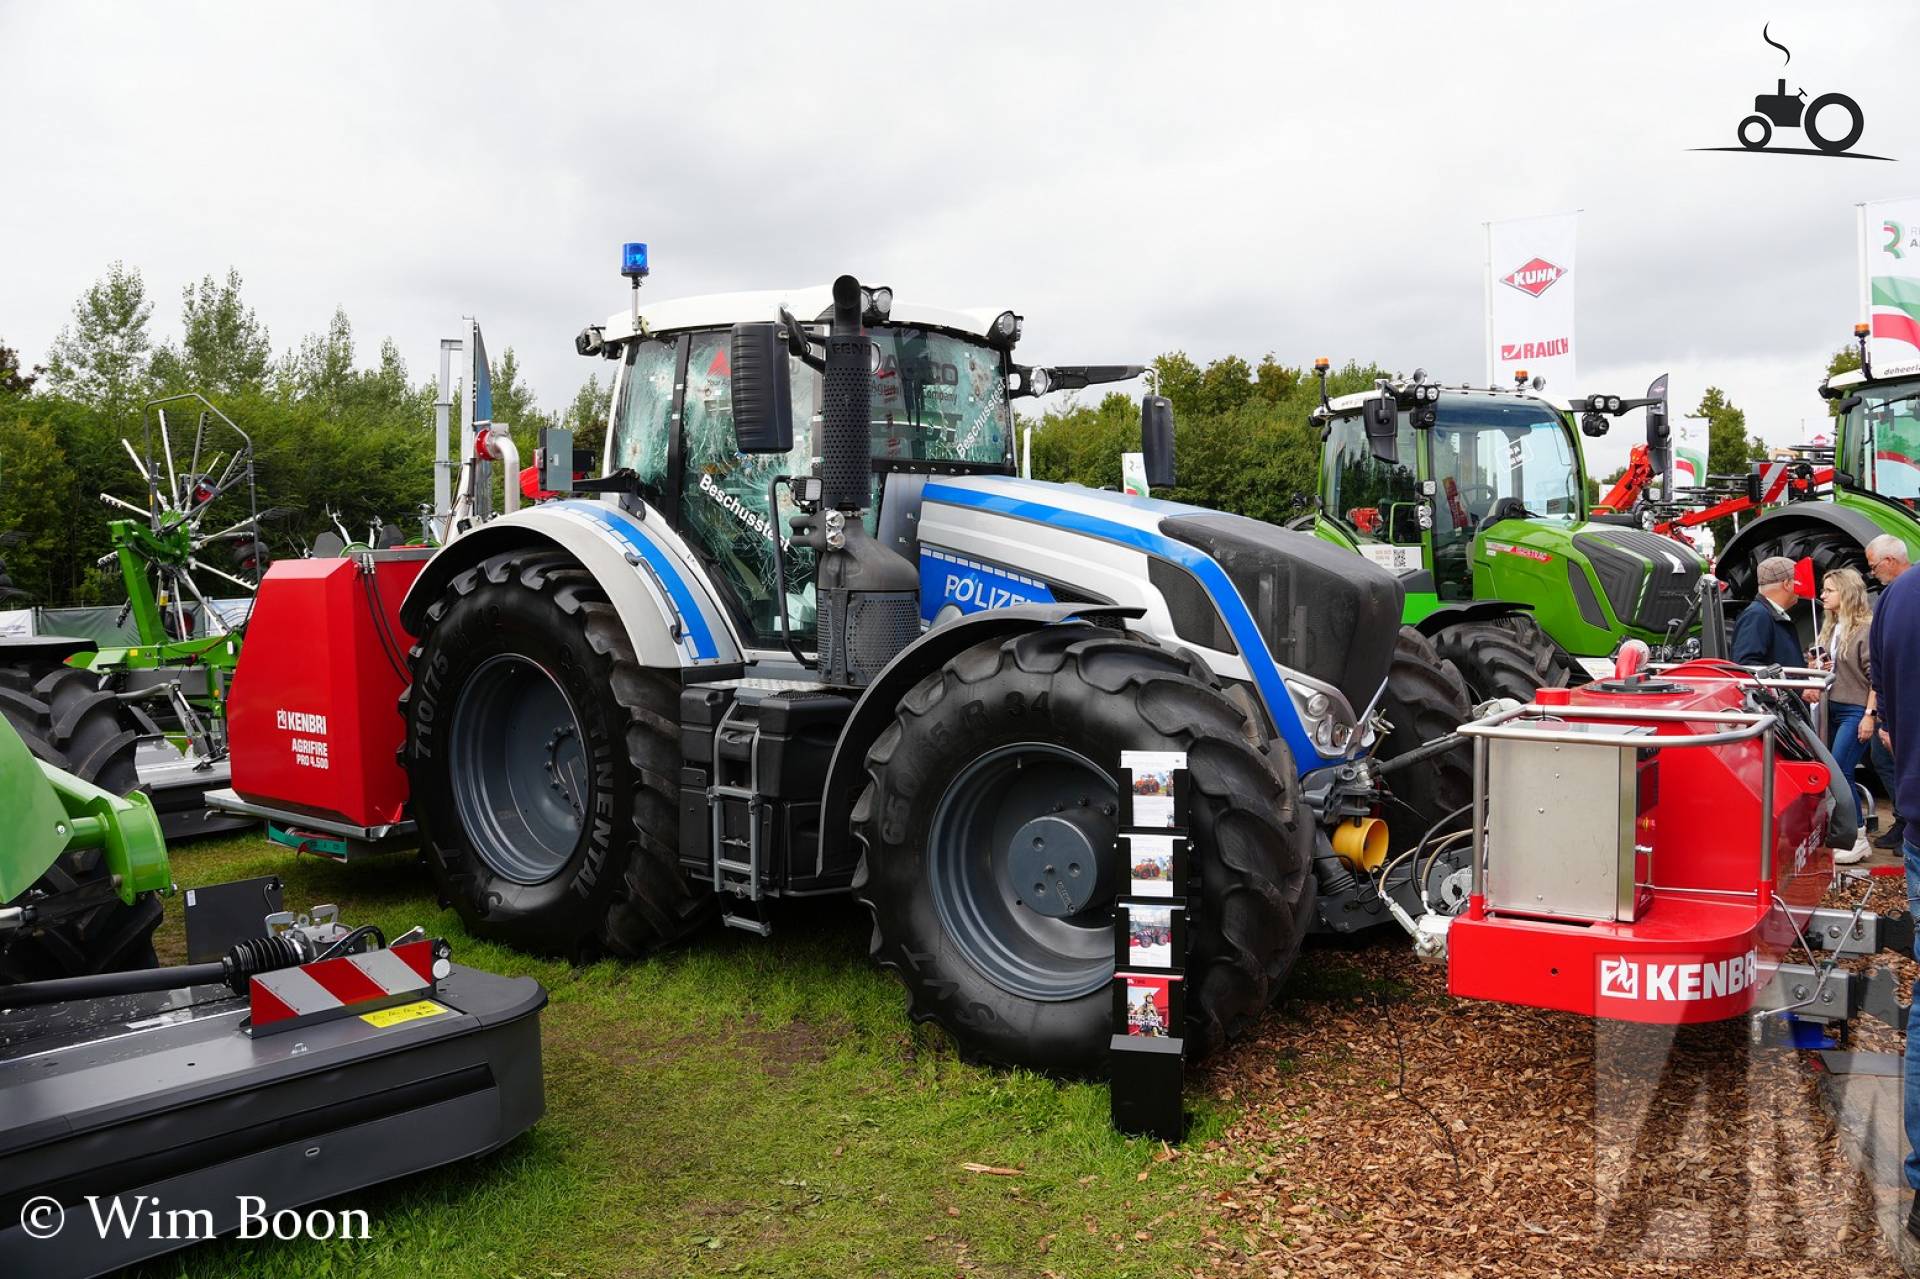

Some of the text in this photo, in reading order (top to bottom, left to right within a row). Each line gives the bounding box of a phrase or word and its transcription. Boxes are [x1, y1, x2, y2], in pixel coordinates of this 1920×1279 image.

[1513, 267, 1559, 287] KUHN
[1523, 337, 1569, 359] RAUCH
[956, 379, 1006, 459] Beschusstest
[944, 574, 1032, 611] POLIZE
[414, 648, 450, 759] 710/75
[960, 700, 992, 729] R
[1004, 691, 1054, 720] 34
[288, 711, 327, 735] KENBRI
[292, 738, 328, 756] AGRIFIRE
[296, 754, 329, 770] PRO 4.500
